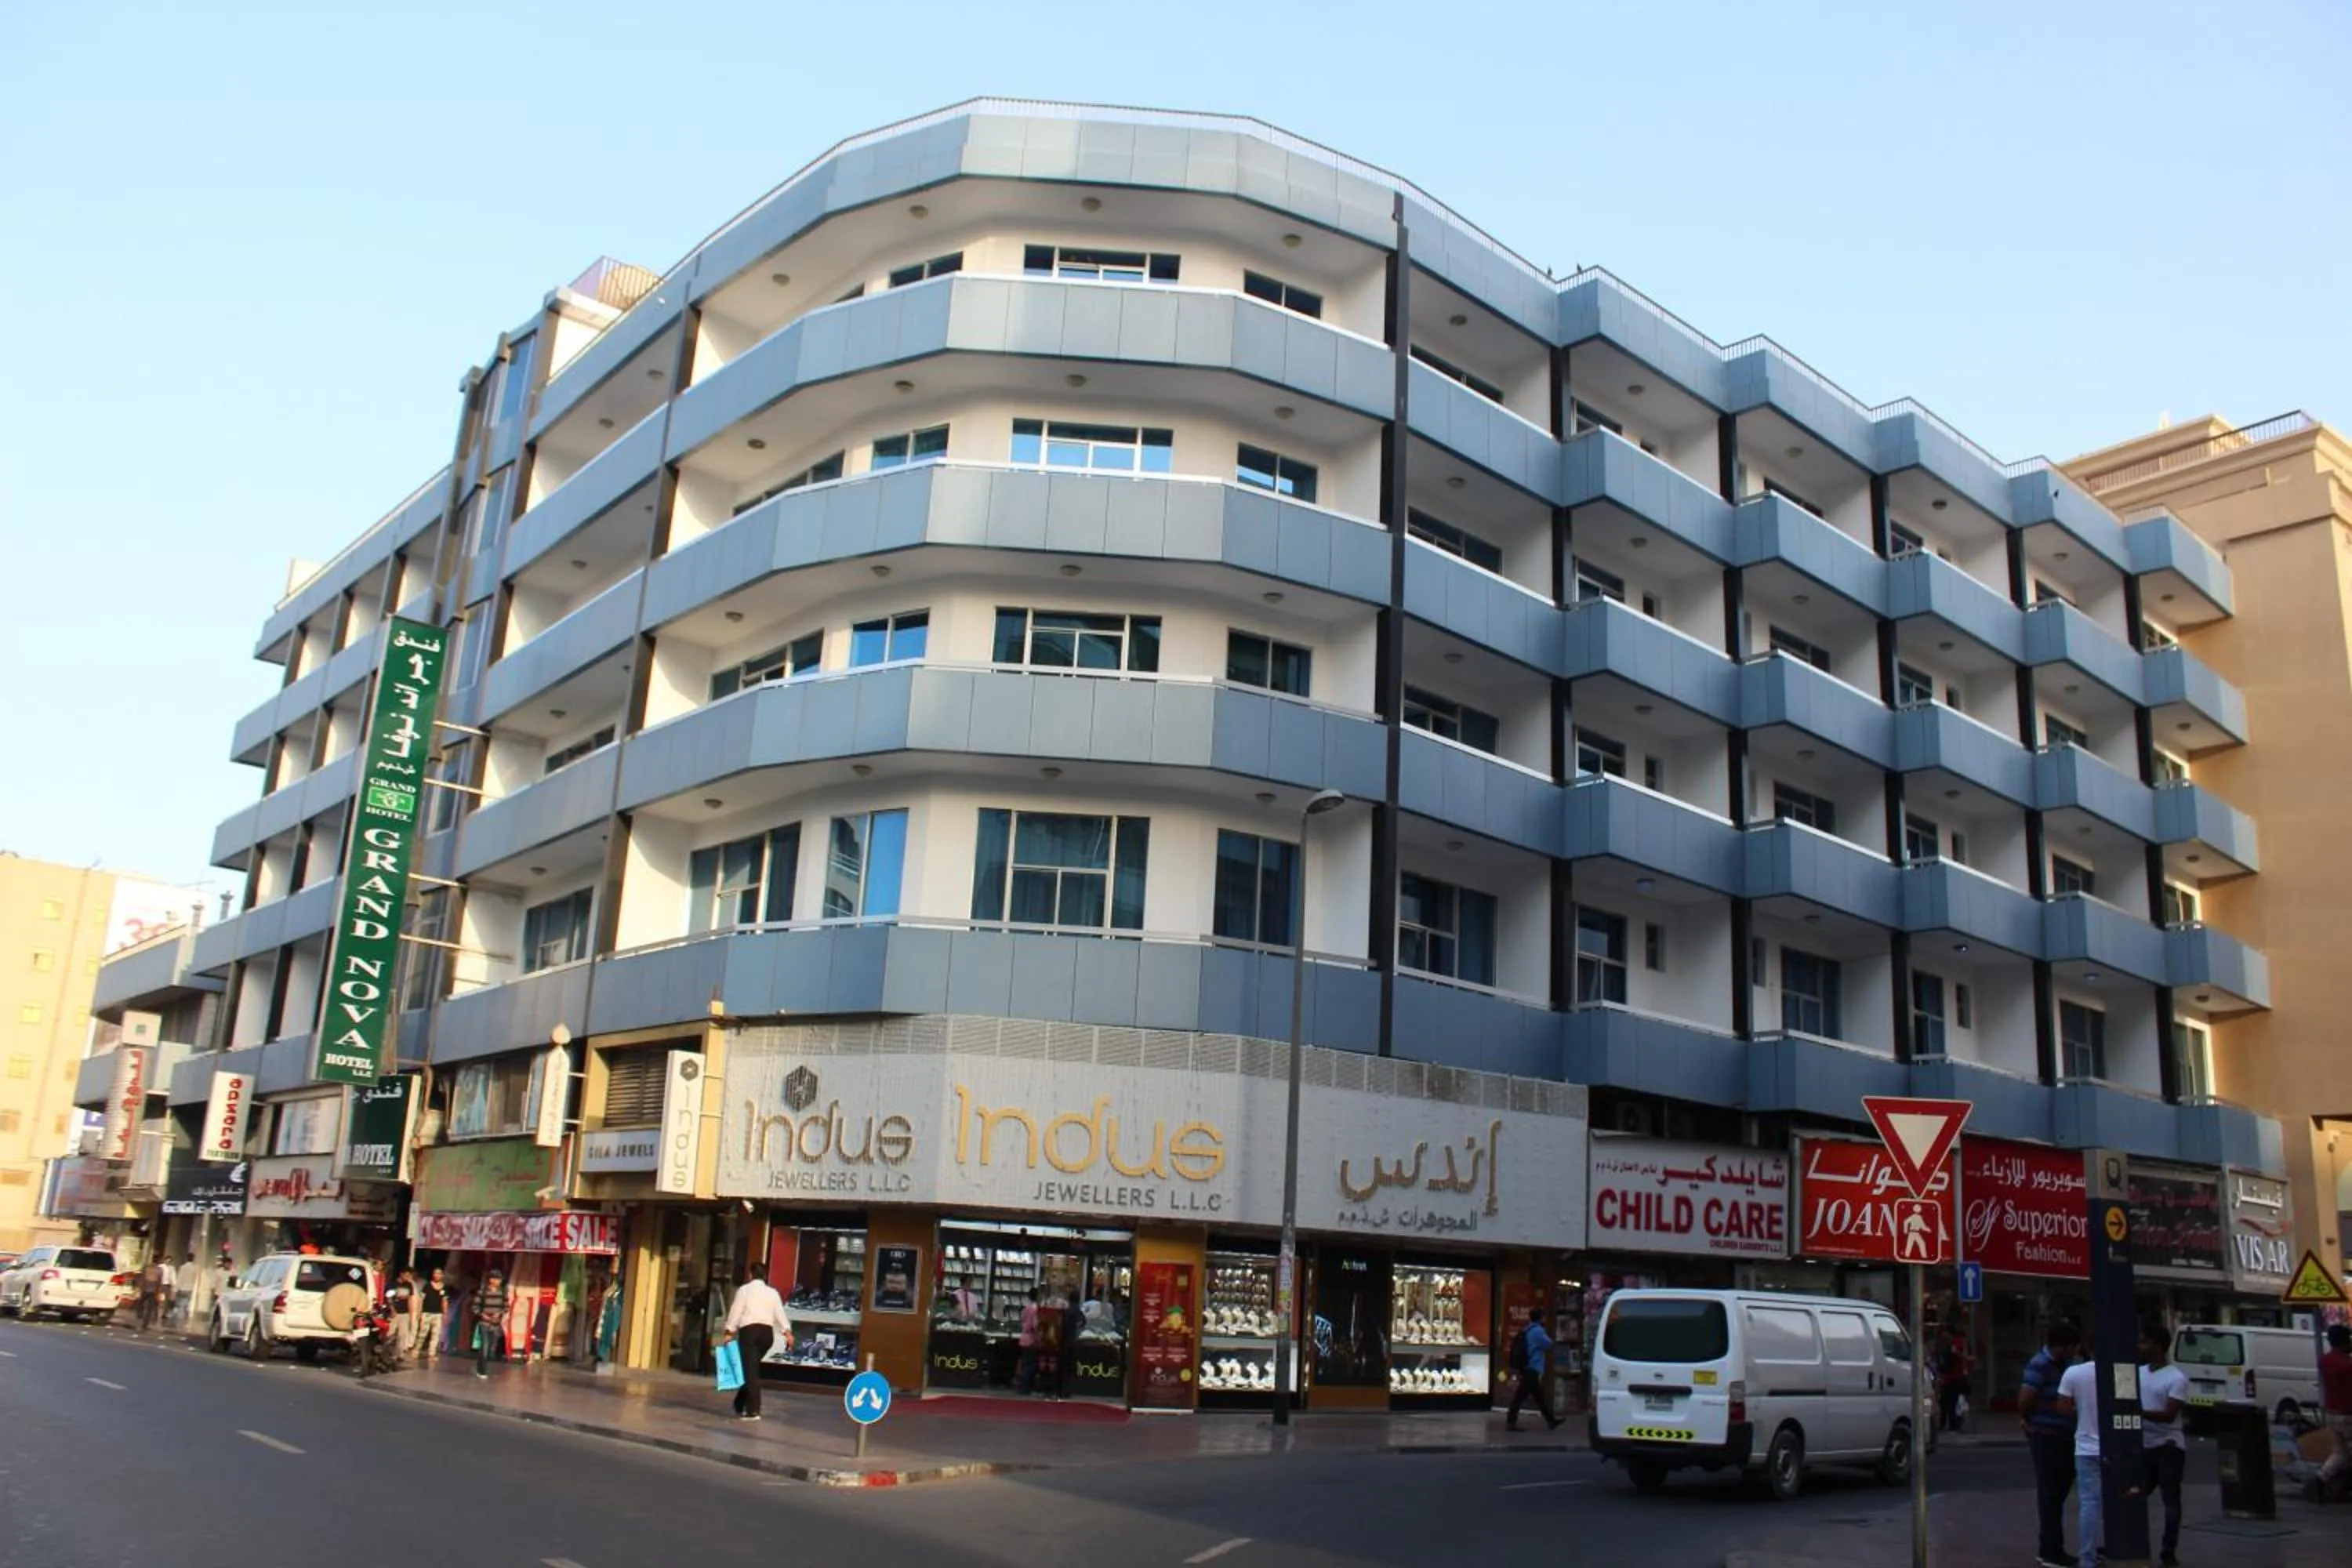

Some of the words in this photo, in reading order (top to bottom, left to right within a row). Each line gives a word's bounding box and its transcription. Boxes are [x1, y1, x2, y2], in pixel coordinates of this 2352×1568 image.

[394, 630, 441, 652] فندق
[369, 777, 416, 794] GRAND
[365, 806, 412, 822] HOTEL
[351, 828, 404, 940] GRAND
[334, 956, 387, 1050] NOVA
[324, 1053, 374, 1071] HOTEL
[743, 1098, 914, 1167] Indus
[956, 1084, 1226, 1181] Indus
[351, 1144, 394, 1166] HOTEL
[768, 1171, 858, 1191] JEWELLERS
[1033, 1181, 1156, 1207] JEWELLERS
[1595, 1187, 1694, 1235] CHILD
[1703, 1197, 1784, 1241] CARE
[2003, 1199, 2088, 1240] Superior
[564, 1214, 618, 1252] SALE
[2016, 1241, 2067, 1264] Fashion
